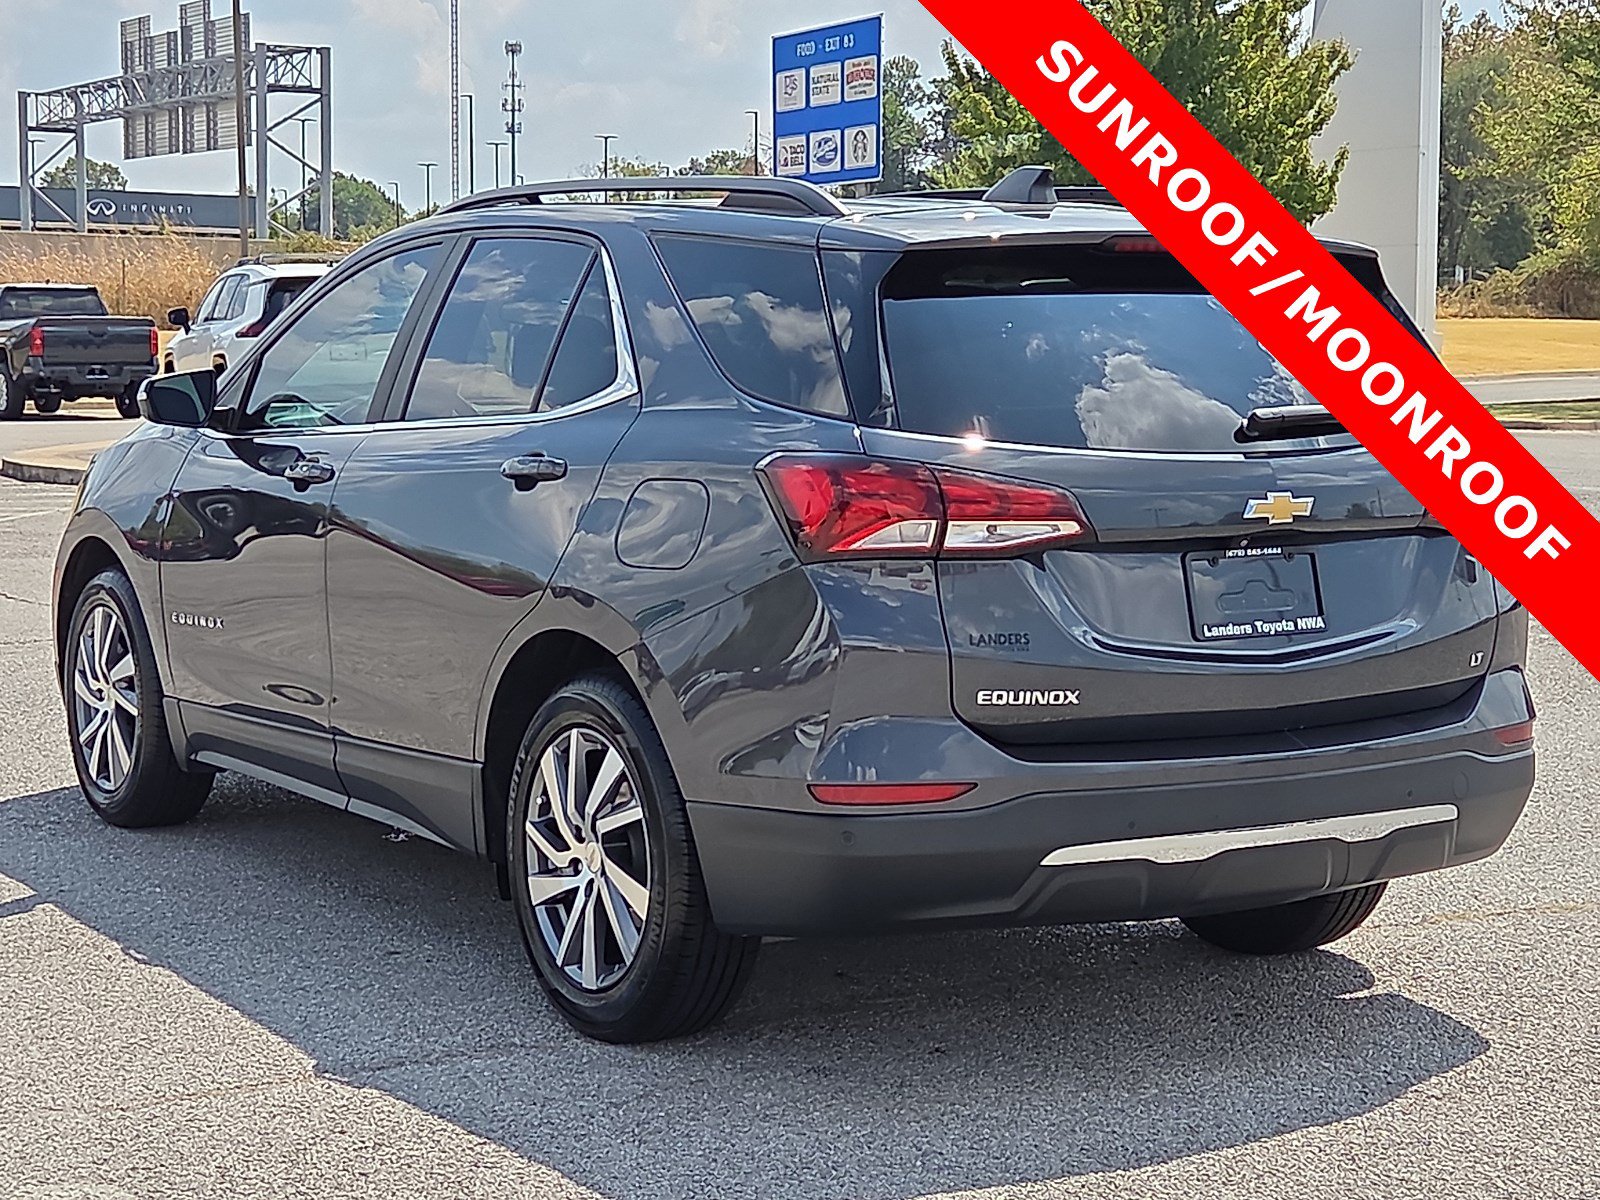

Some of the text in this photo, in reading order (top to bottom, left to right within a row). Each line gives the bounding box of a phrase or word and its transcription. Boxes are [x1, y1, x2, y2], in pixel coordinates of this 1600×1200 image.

[797, 41, 816, 56] FOOD
[825, 36, 840, 52] EXIT
[789, 144, 805, 155] TACO
[790, 155, 805, 167] BELL
[122, 203, 192, 214] INFINITI
[171, 611, 225, 629] EQUINOX
[1203, 616, 1325, 637] Landers Toyota NWA
[969, 632, 1030, 647] LANDERS
[1470, 652, 1484, 667] LT
[976, 690, 1080, 706] EQUINOX
